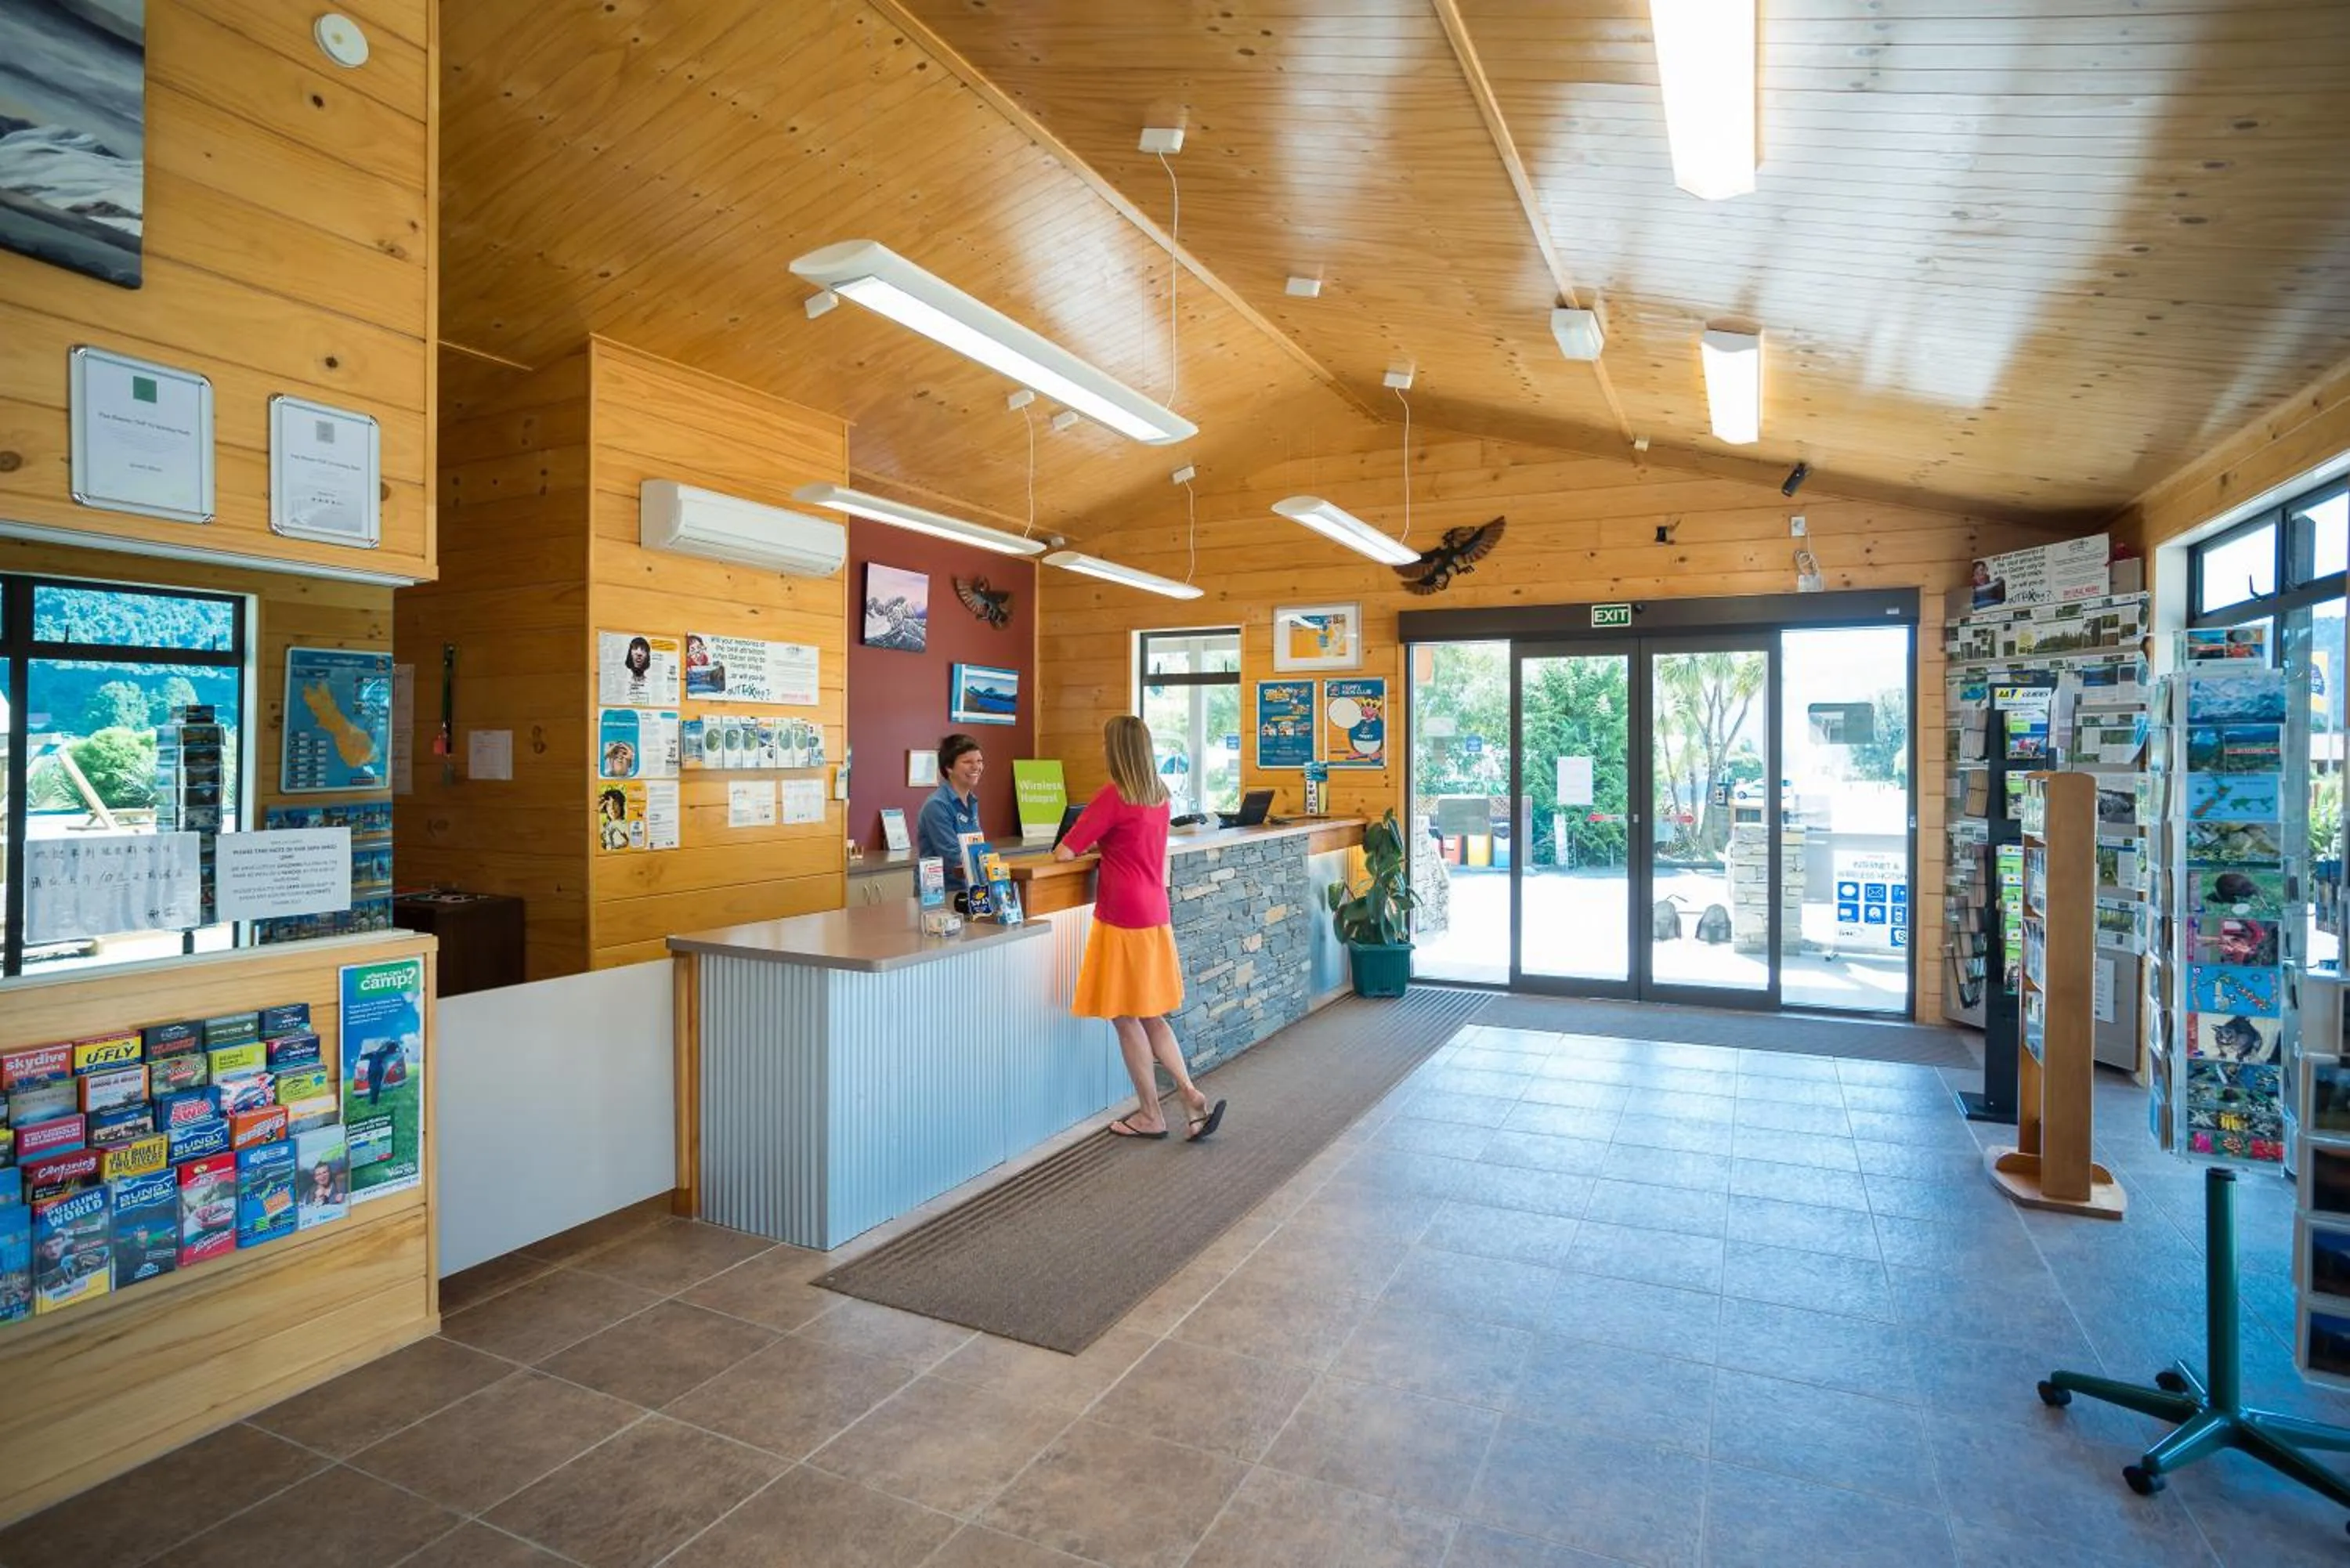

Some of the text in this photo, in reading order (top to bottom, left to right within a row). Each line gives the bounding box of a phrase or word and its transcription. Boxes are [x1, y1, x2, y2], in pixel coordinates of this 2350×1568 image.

[1594, 609, 1629, 623] EXIT
[1018, 779, 1063, 790] Wireless
[361, 966, 416, 991] camp?
[5, 1052, 67, 1071] skydive
[86, 1045, 135, 1064] U-FLY
[173, 1132, 223, 1154] BUNGY
[120, 1180, 174, 1202] BUNGY
[49, 1198, 103, 1227] WORLD
